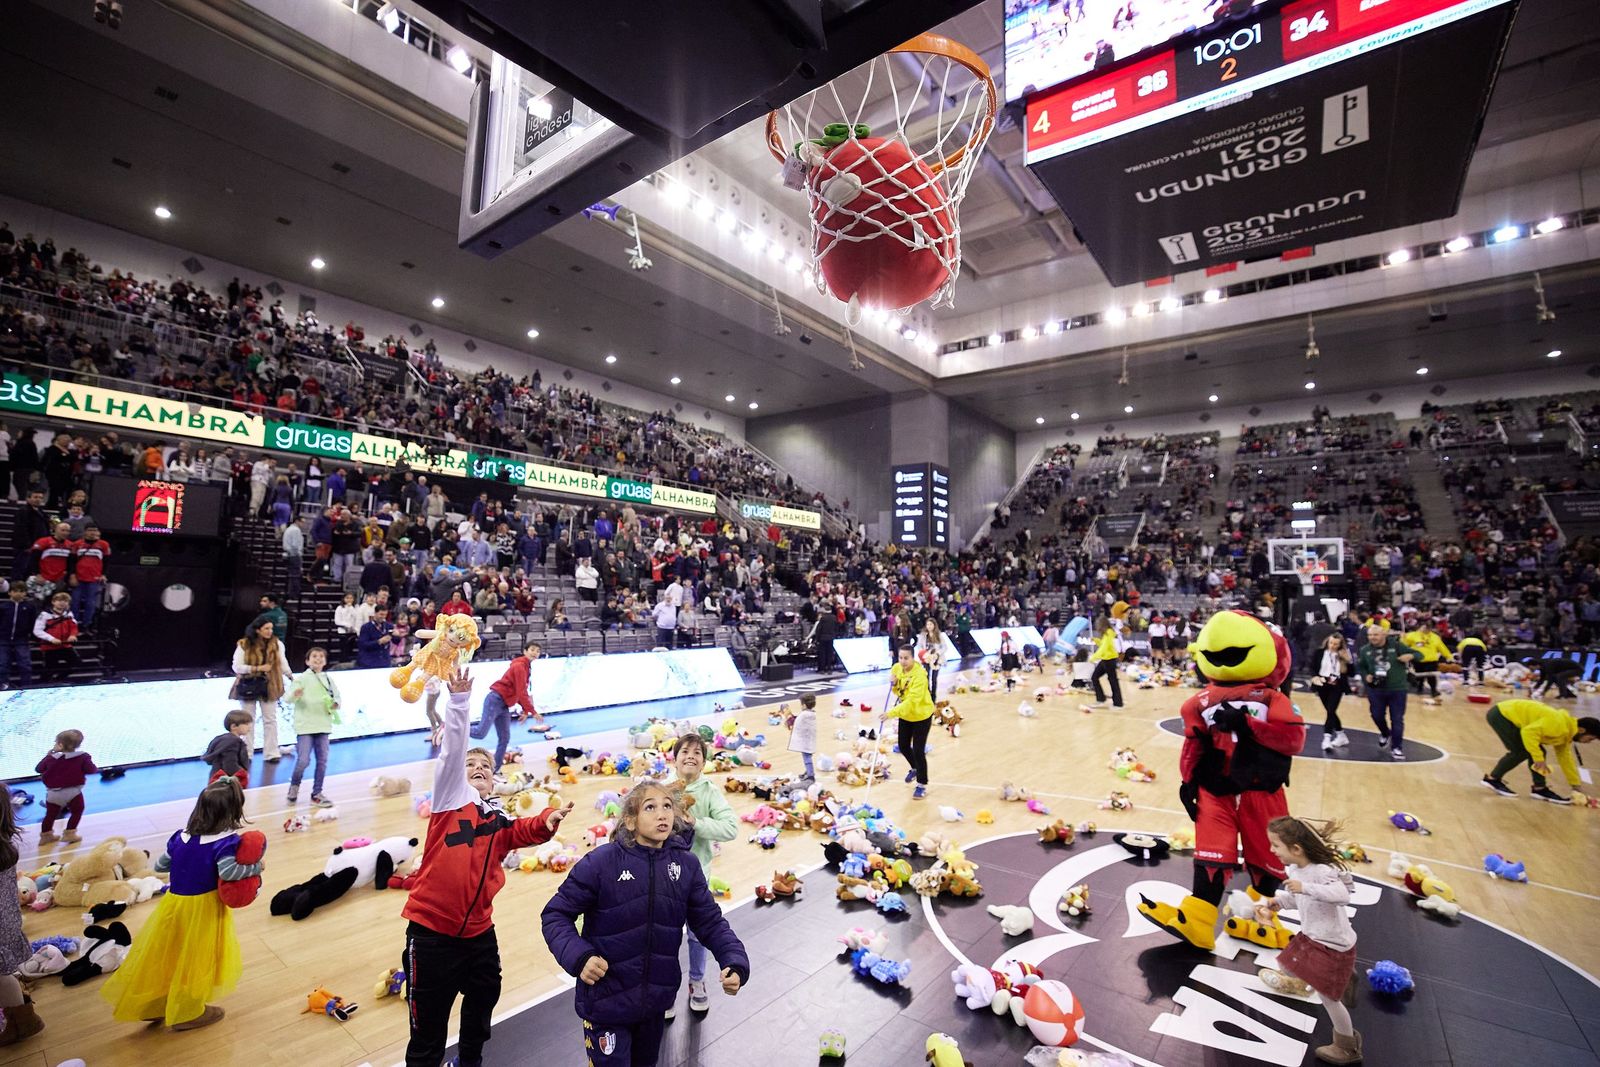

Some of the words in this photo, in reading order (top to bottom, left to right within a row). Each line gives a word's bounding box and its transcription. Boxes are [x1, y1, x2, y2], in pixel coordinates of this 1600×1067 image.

[1289, 9, 1329, 43] 34
[1193, 23, 1261, 66] 10:01
[1219, 57, 1238, 82] 2
[526, 109, 571, 148] endesa
[1032, 110, 1051, 134] 4
[1219, 126, 1306, 165] 2031
[1206, 224, 1276, 249] 2031
[53, 390, 250, 436] ALHAMBRA
[275, 425, 351, 454] grúas
[528, 468, 607, 493] ALHAMBRA
[611, 478, 652, 499] grúas
[653, 490, 716, 509] ALHAMBRA
